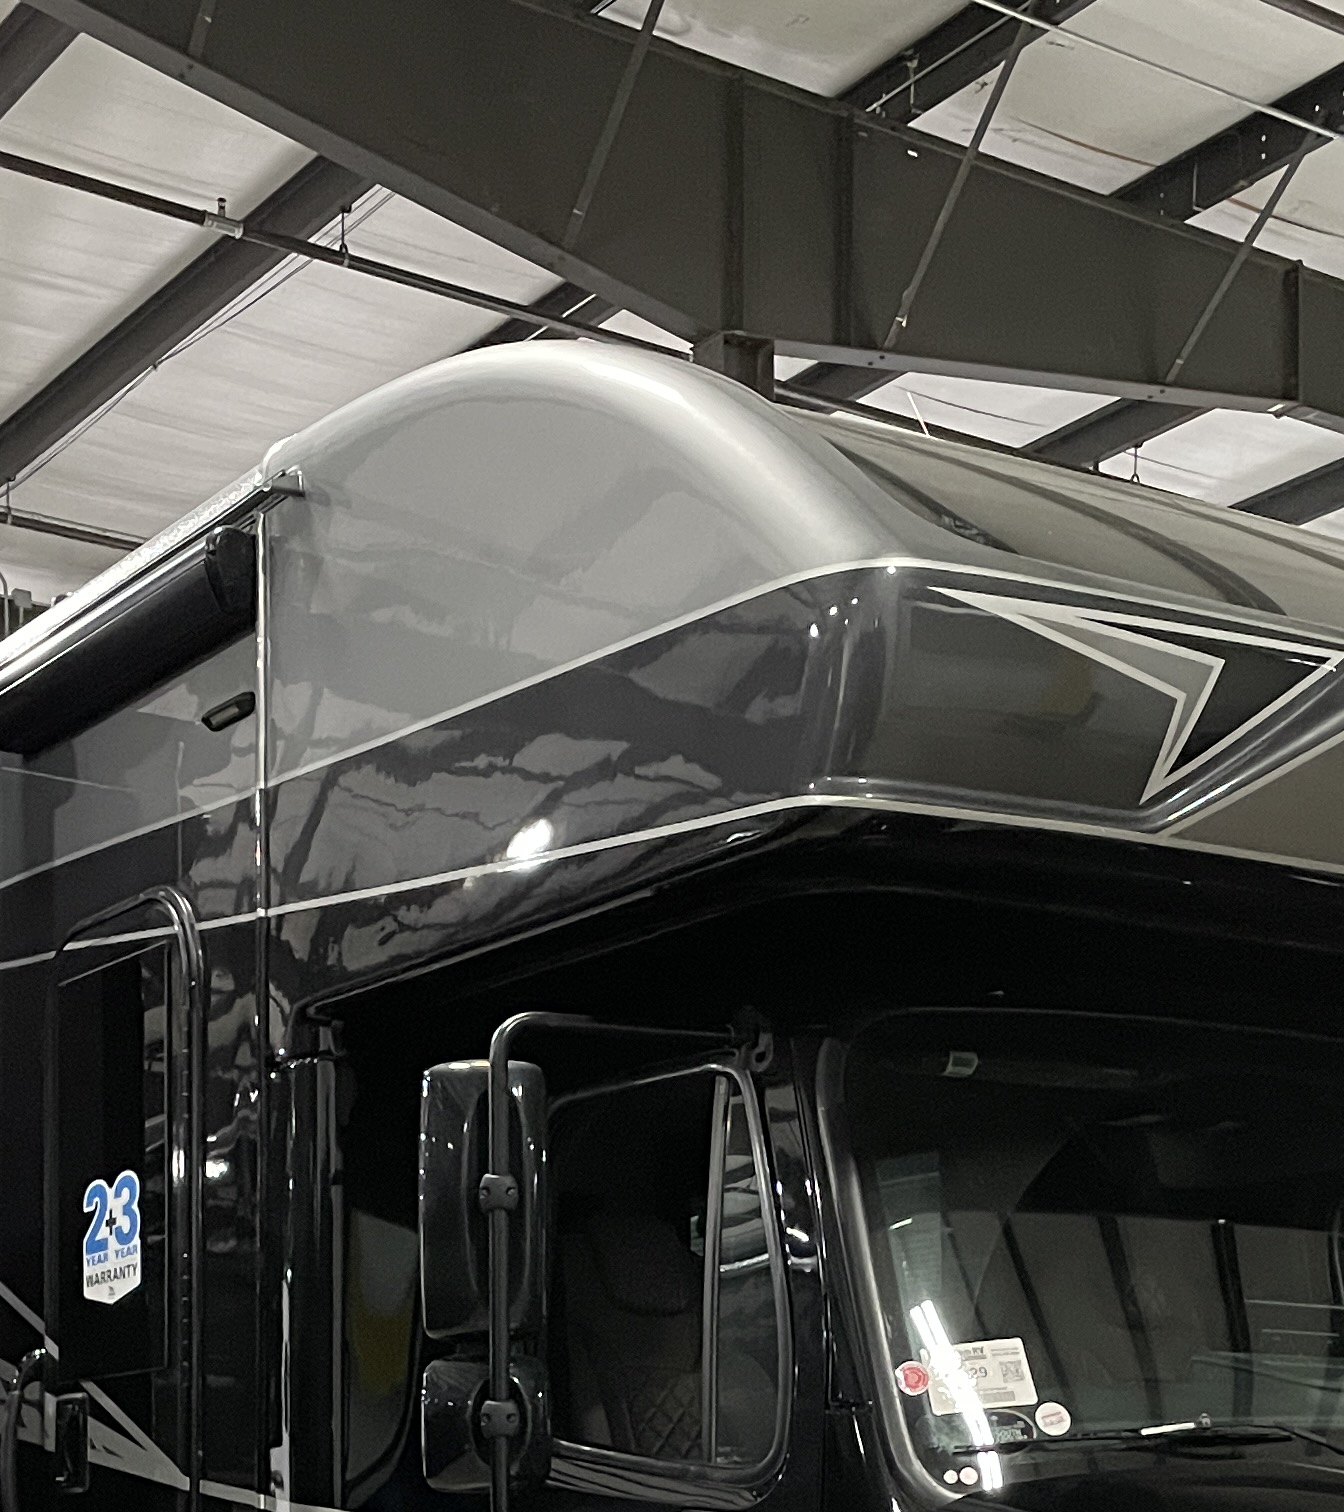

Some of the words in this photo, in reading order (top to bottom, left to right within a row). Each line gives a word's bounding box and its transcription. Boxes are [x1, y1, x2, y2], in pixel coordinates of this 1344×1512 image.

[86, 1252, 108, 1267] YEAR
[115, 1244, 138, 1260] YEAR
[85, 1263, 138, 1287] WARRANTY
